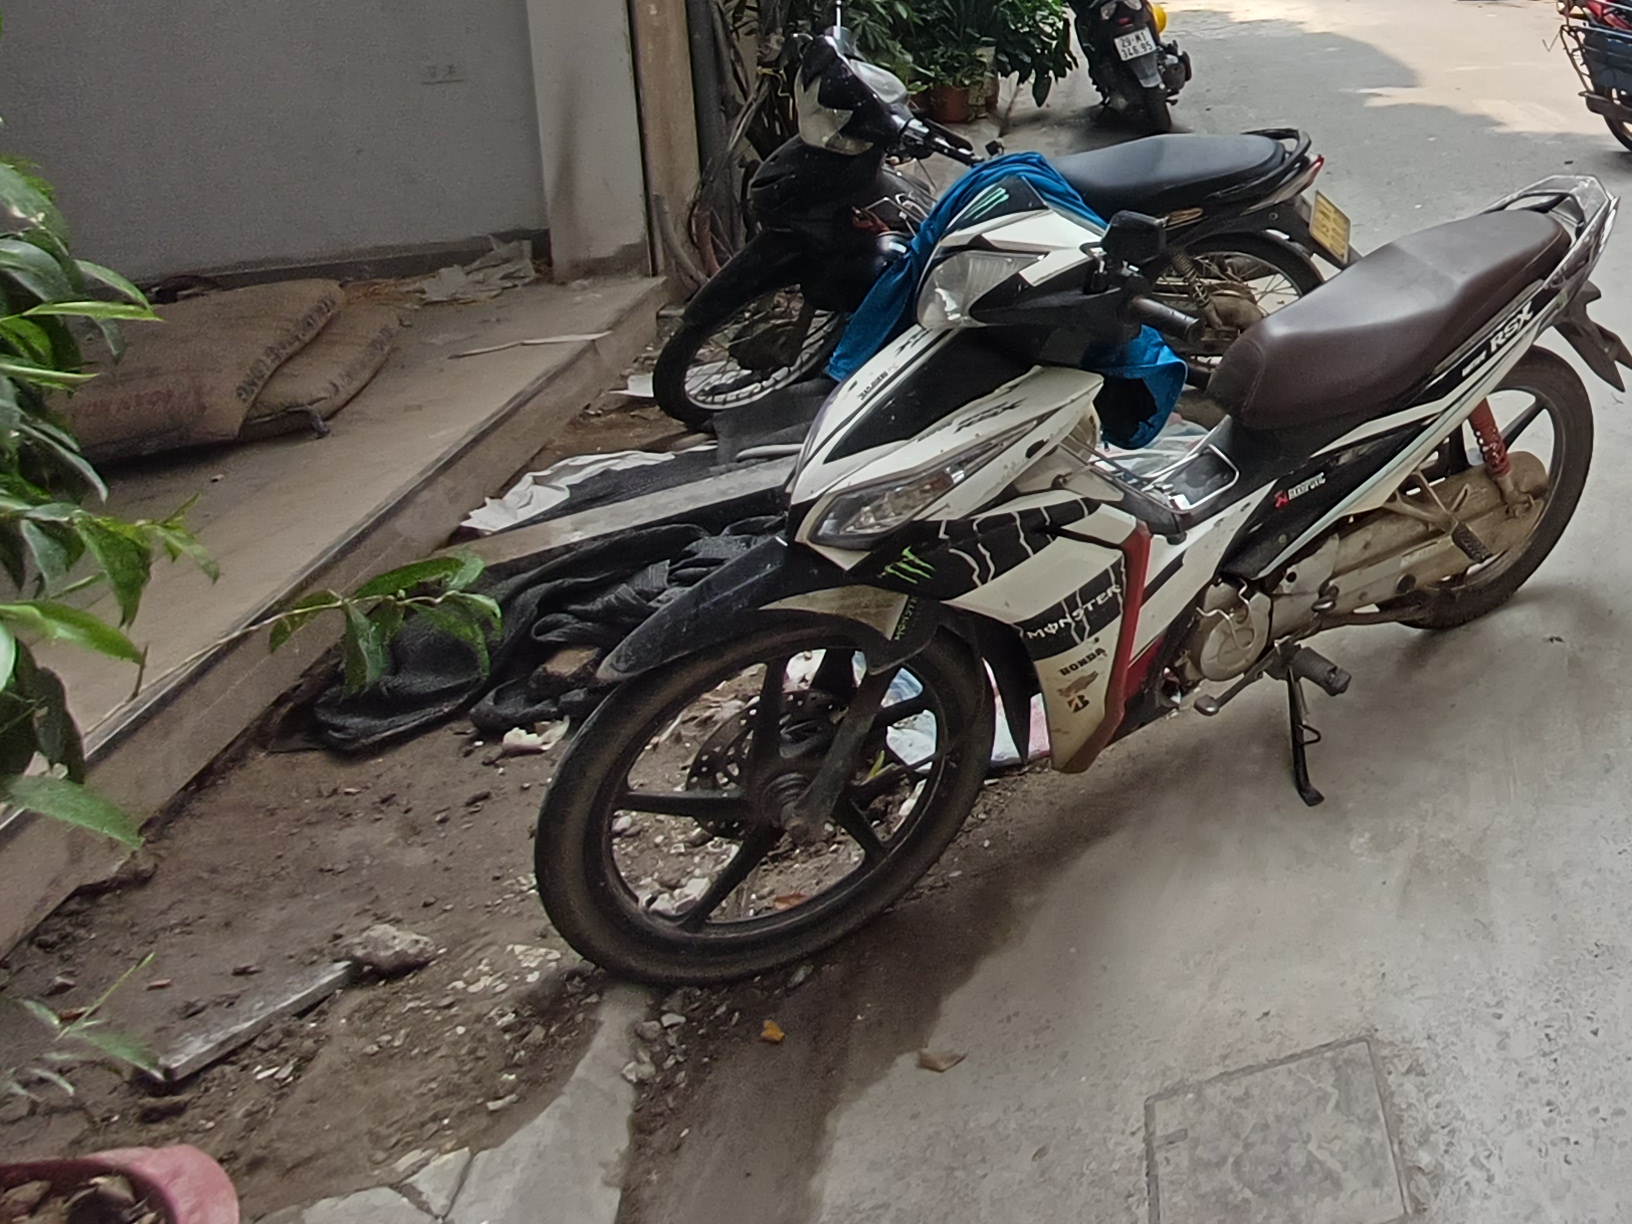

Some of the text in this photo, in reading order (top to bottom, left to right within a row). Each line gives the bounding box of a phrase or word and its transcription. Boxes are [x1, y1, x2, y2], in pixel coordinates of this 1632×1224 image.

[1490, 301, 1534, 353] RSX
[1027, 584, 1122, 639] MONSTER
[1059, 647, 1107, 676] HONDA
